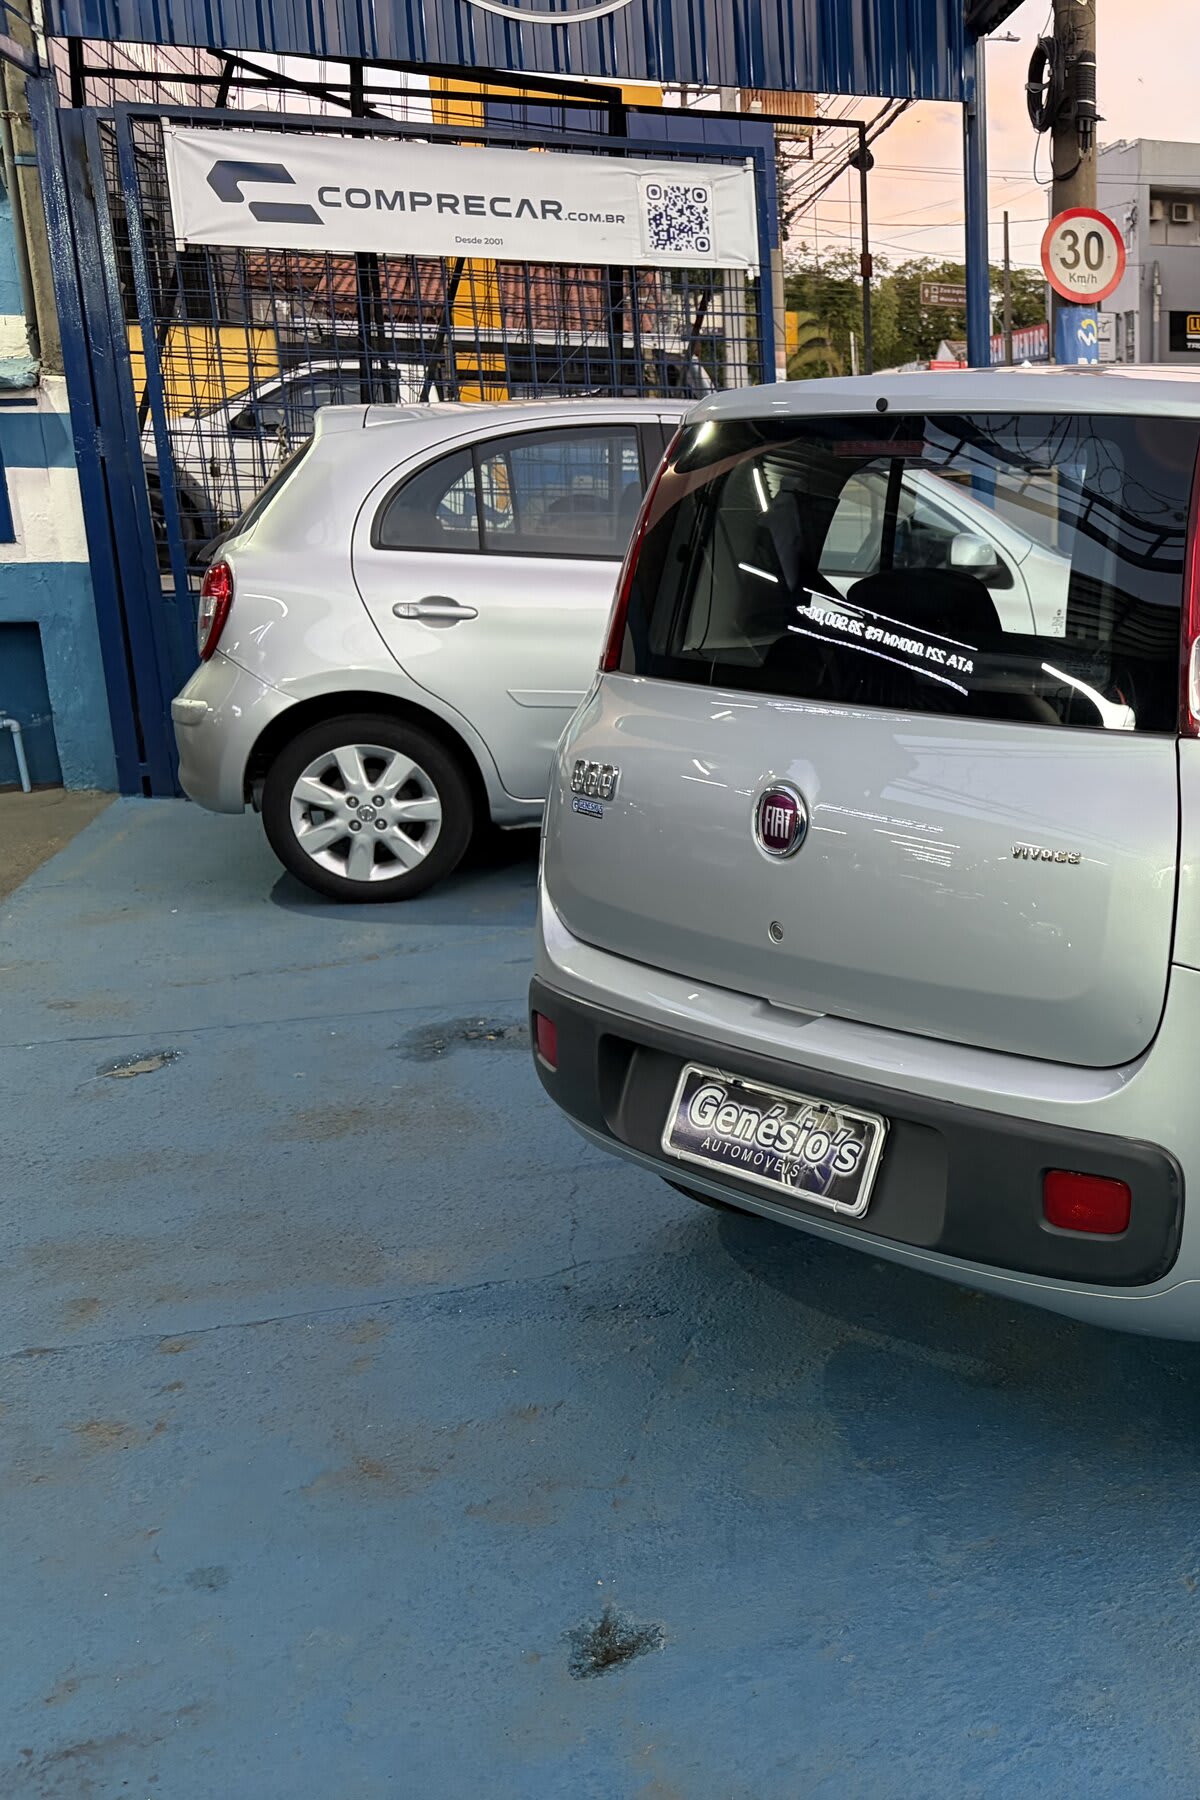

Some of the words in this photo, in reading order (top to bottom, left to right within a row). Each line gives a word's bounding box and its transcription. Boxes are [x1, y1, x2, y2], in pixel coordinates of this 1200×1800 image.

[455, 236, 482, 245] Desde
[484, 237, 504, 246] 2001
[1060, 229, 1105, 271] 30
[1069, 273, 1098, 284] Km/h
[764, 805, 794, 840] FIAT
[687, 1083, 864, 1176] Genésio's
[701, 1137, 801, 1178] AUTOMÓVEIS
